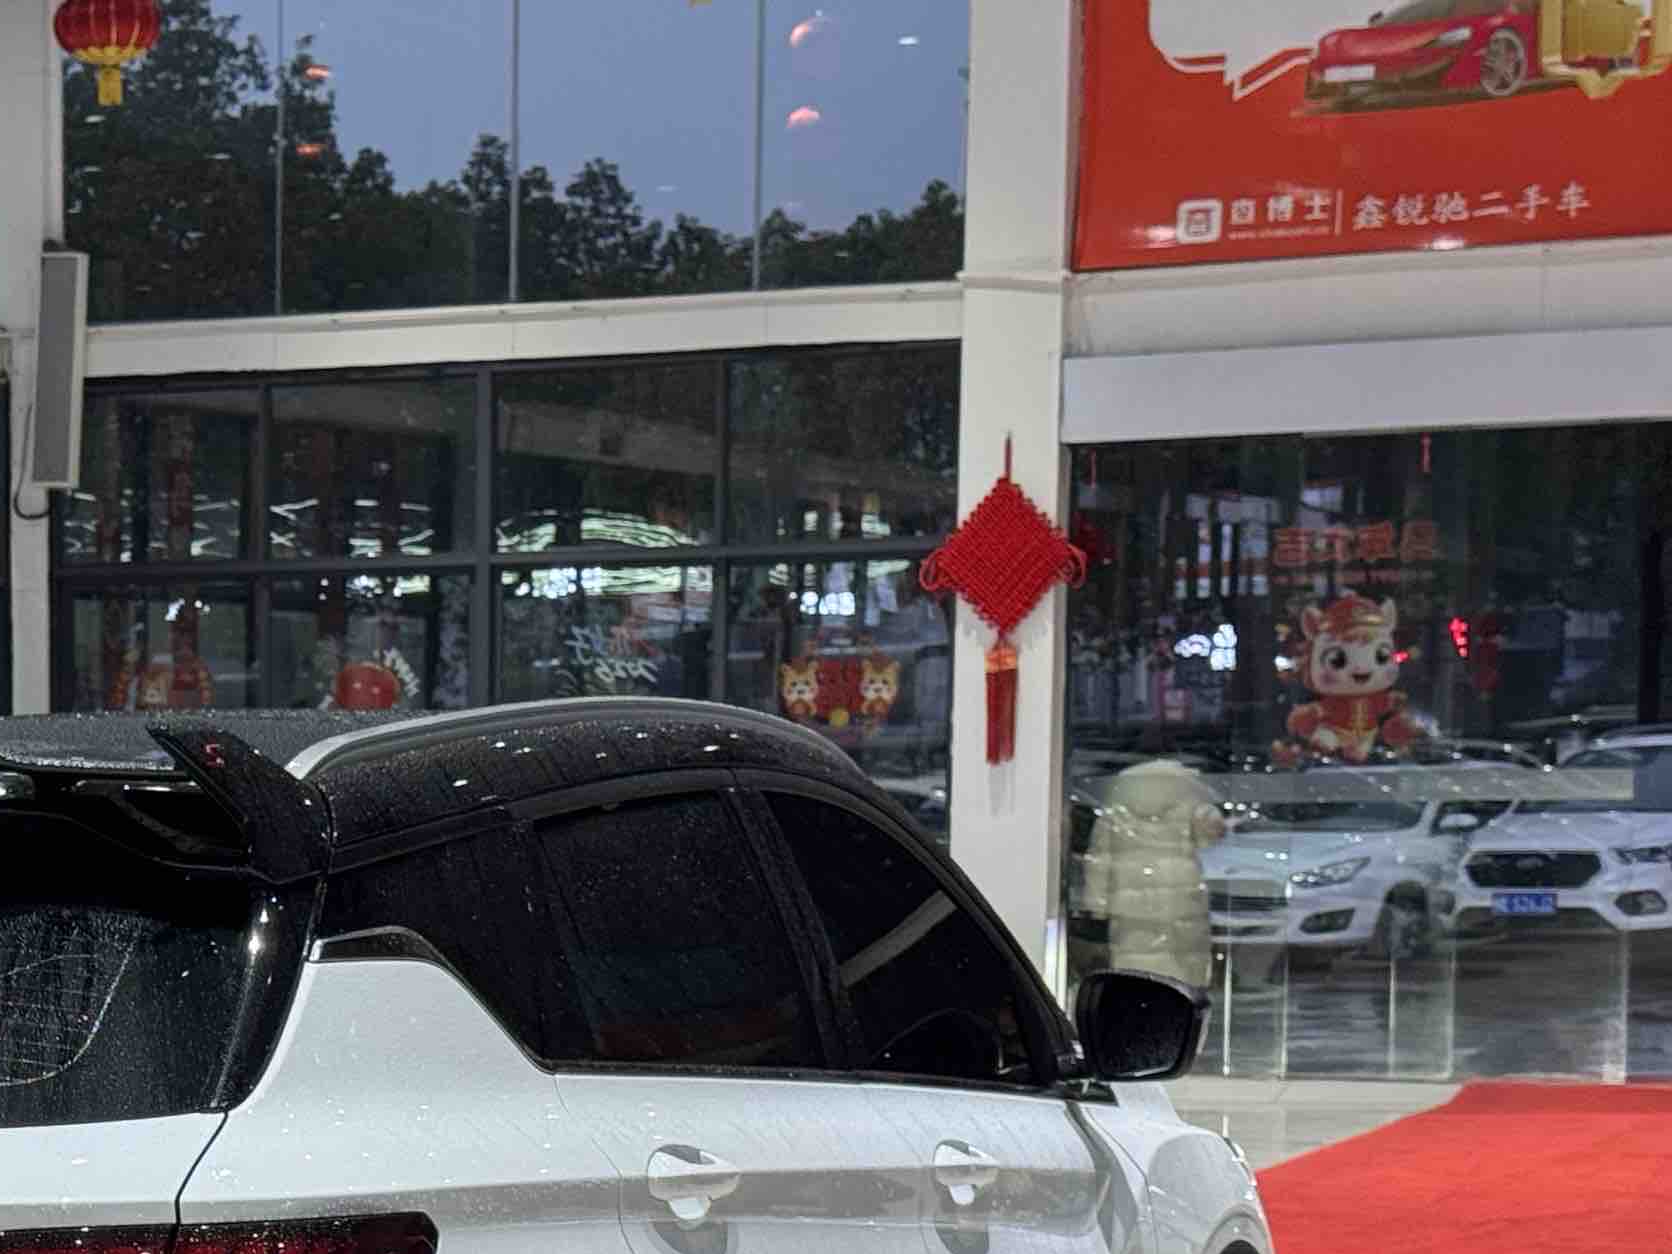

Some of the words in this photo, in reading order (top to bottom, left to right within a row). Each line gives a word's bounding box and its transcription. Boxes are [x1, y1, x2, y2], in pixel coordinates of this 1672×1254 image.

[1353, 180, 1591, 232] 鑫锐驰二手车
